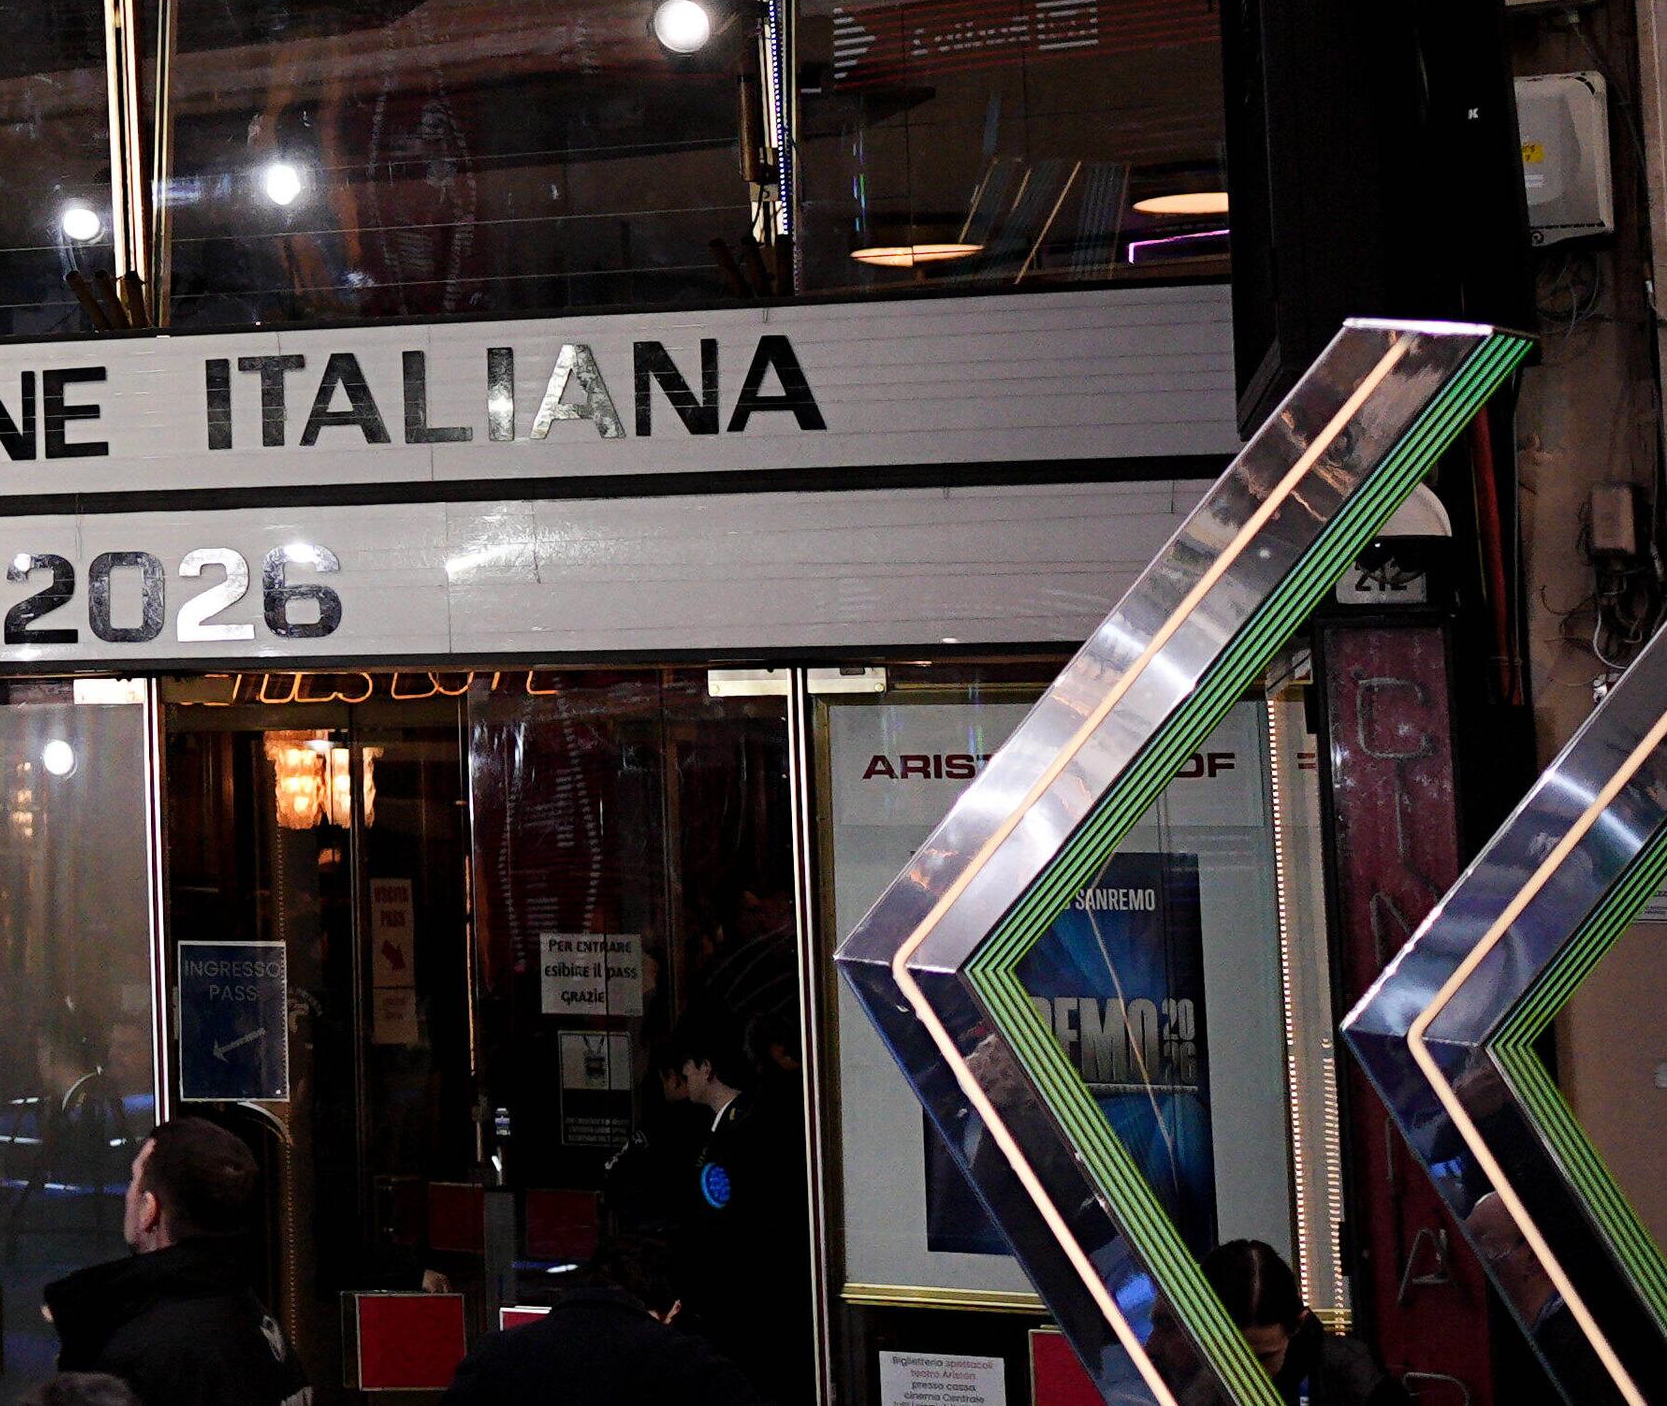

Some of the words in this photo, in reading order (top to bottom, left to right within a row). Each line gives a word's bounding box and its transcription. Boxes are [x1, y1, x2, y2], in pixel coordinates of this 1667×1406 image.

[206, 335, 827, 451] ITALIANA
[5, 541, 342, 645] 2026
[863, 753, 991, 780] ARIS
[1075, 887, 1156, 911] SANREMO
[184, 960, 281, 978] INGRESSO
[209, 984, 257, 1002] PASS
